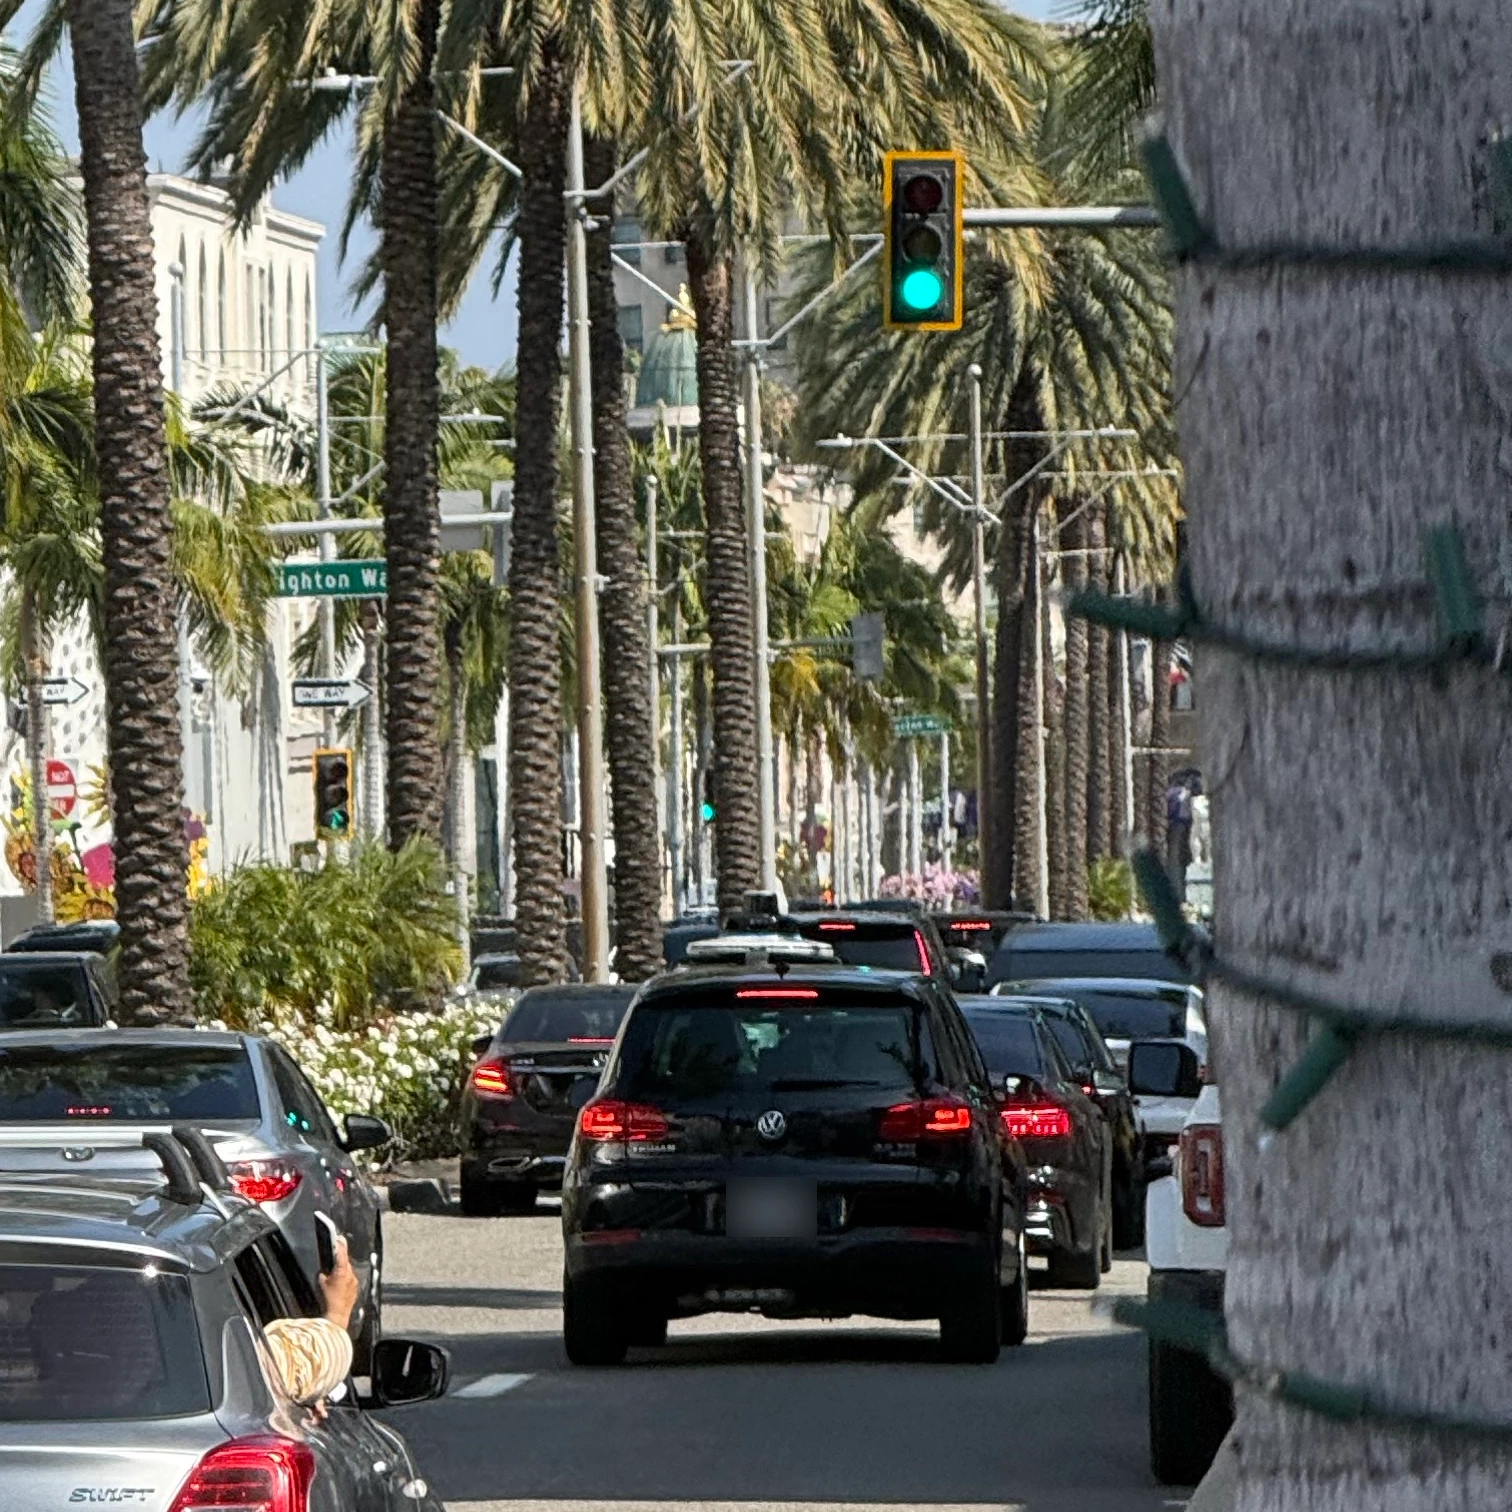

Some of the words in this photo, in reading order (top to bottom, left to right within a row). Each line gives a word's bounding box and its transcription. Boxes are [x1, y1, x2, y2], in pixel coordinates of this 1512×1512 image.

[278, 569, 350, 595] ighton
[361, 568, 387, 588] Wa
[324, 687, 345, 698] WAY
[68, 1487, 156, 1503] SWIFT
